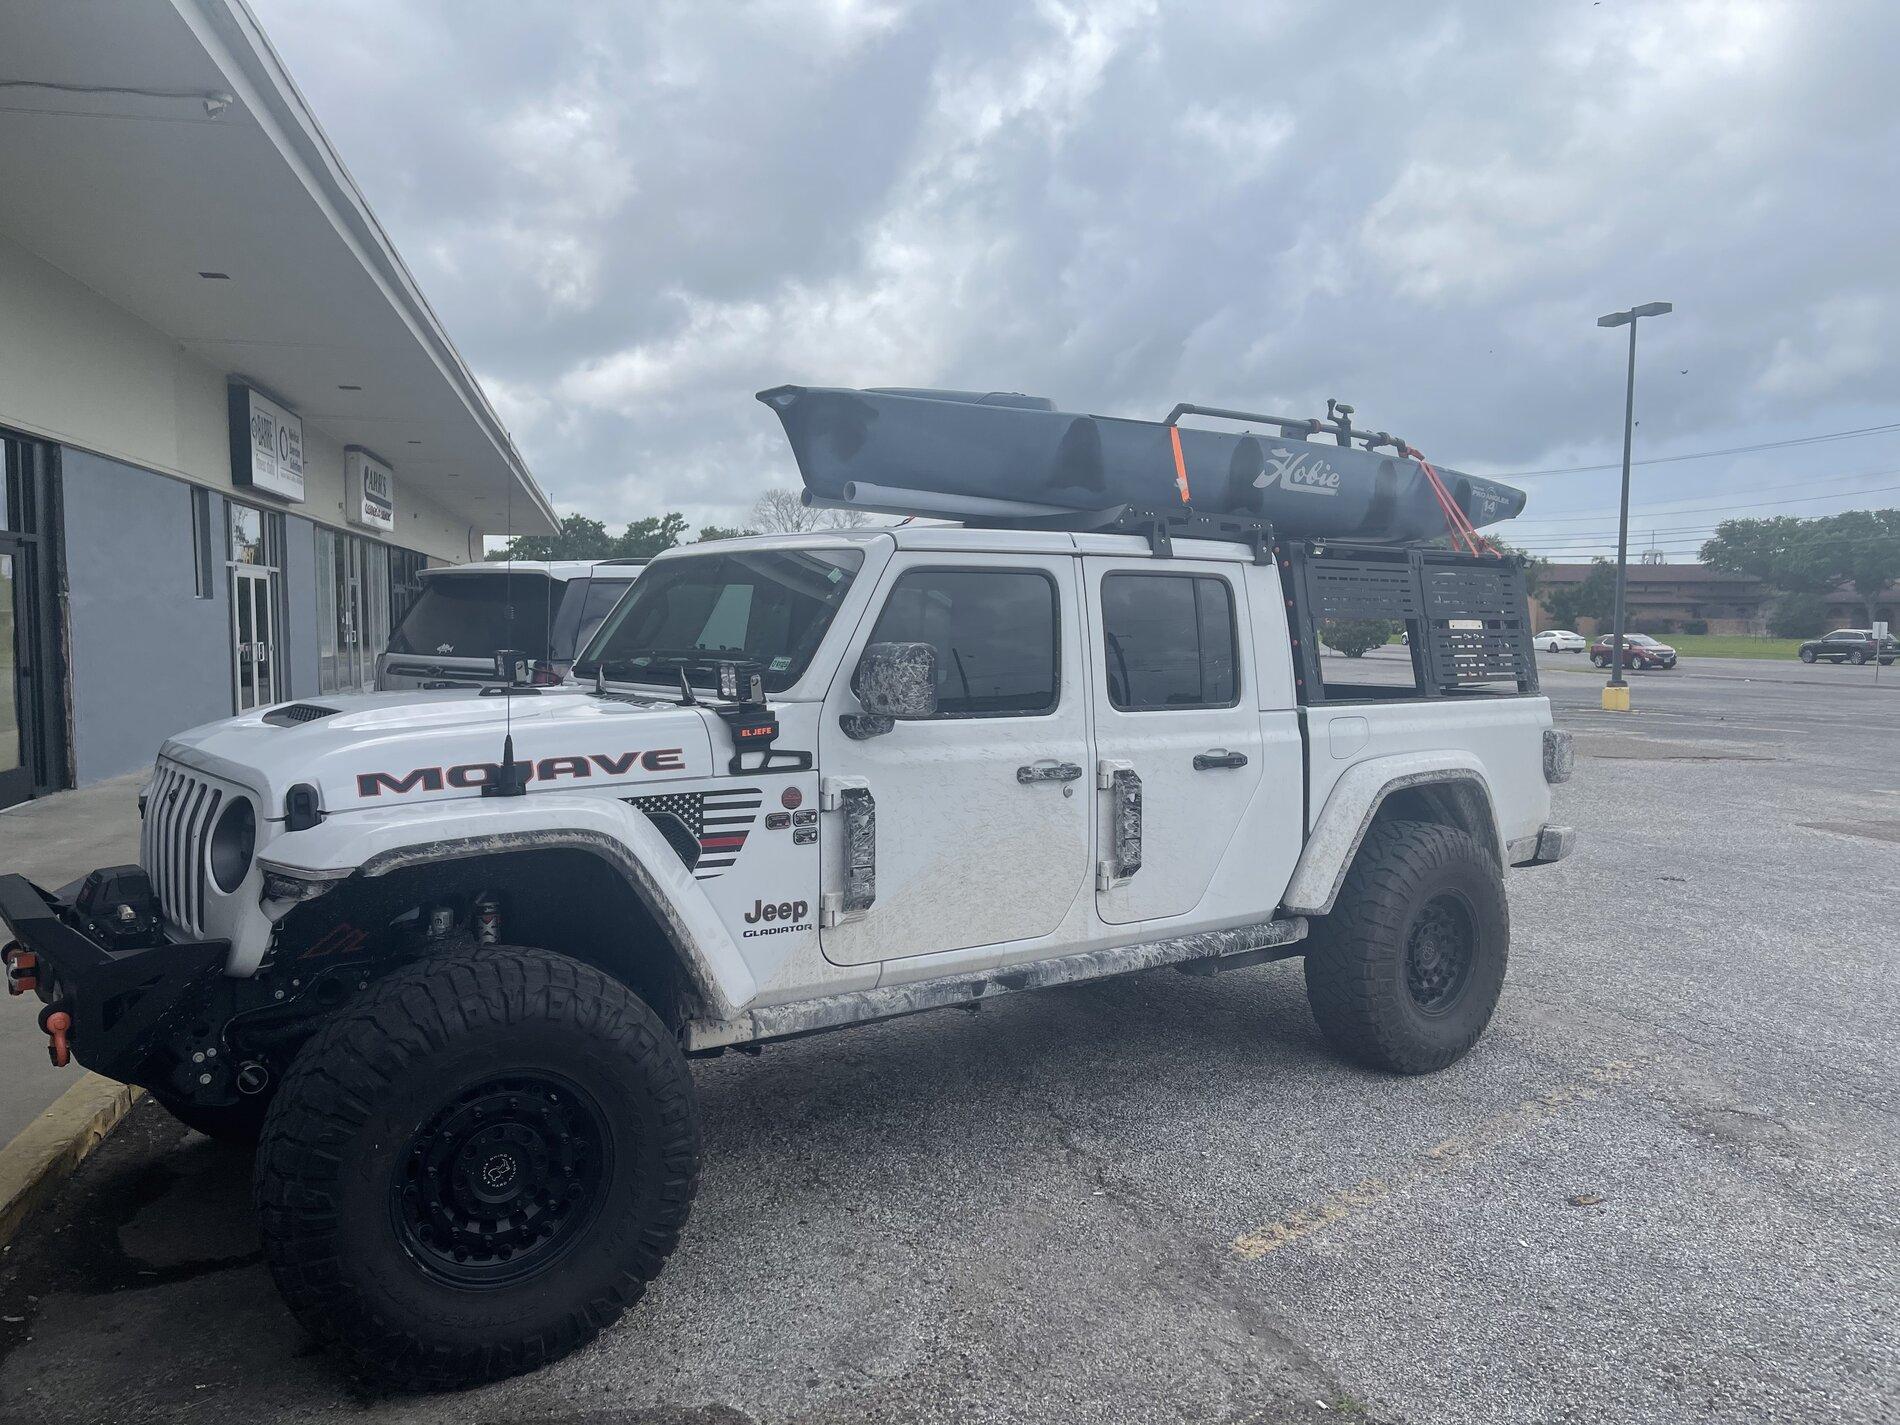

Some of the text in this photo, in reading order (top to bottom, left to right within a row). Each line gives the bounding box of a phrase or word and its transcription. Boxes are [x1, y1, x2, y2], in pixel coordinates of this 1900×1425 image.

[1252, 447, 1341, 496] Hobie
[741, 727, 772, 737] EL JEFE
[356, 748, 686, 797] MOJAVE
[744, 899, 808, 924] Jeep
[742, 923, 813, 938] GLADIATOR
